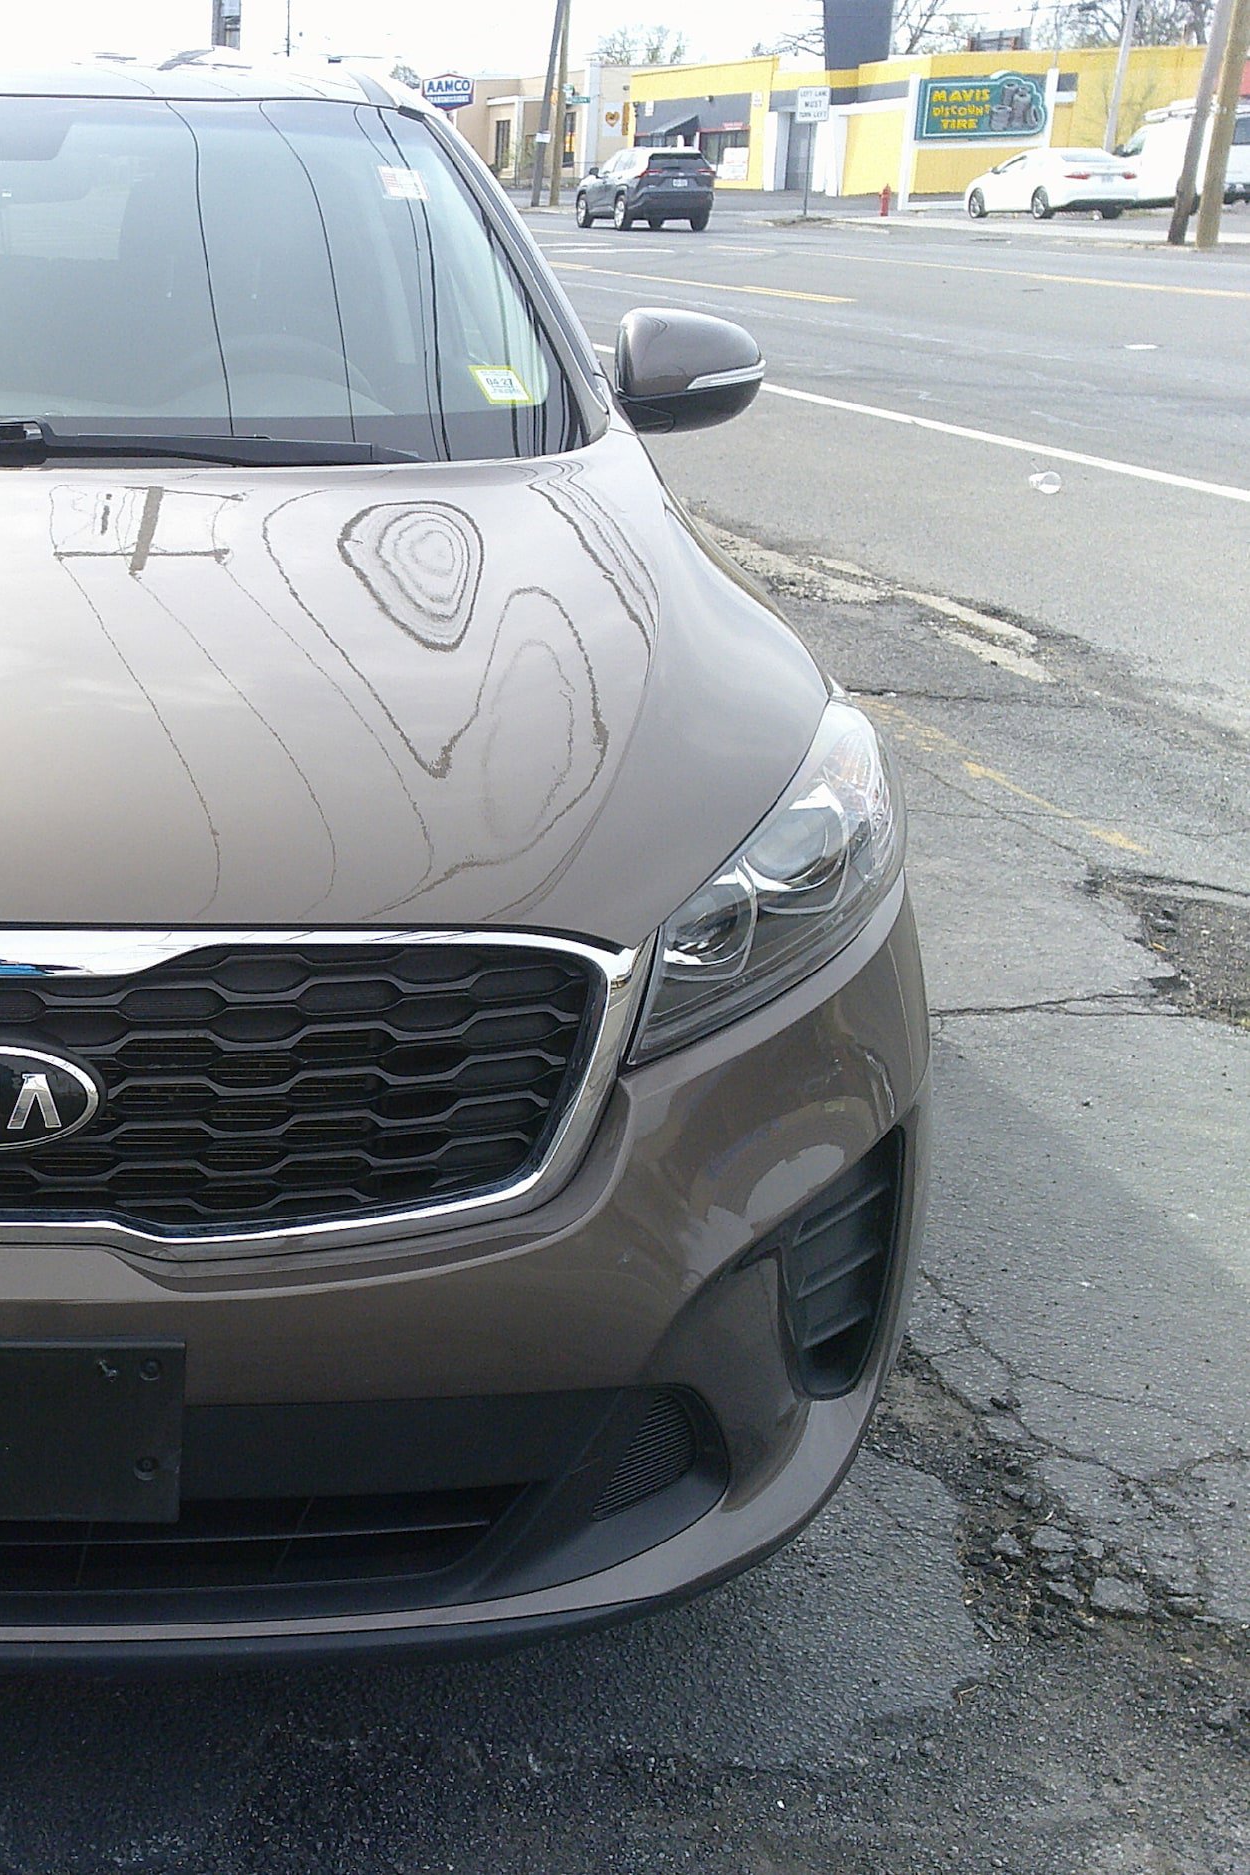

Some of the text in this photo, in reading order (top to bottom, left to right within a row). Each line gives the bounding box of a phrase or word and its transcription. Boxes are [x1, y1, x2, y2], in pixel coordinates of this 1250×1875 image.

[426, 80, 470, 93] AAMCO
[932, 89, 991, 102] MAVIS
[804, 100, 822, 108] MUST
[932, 104, 991, 117] DISCOUNT
[941, 118, 979, 130] TIRE
